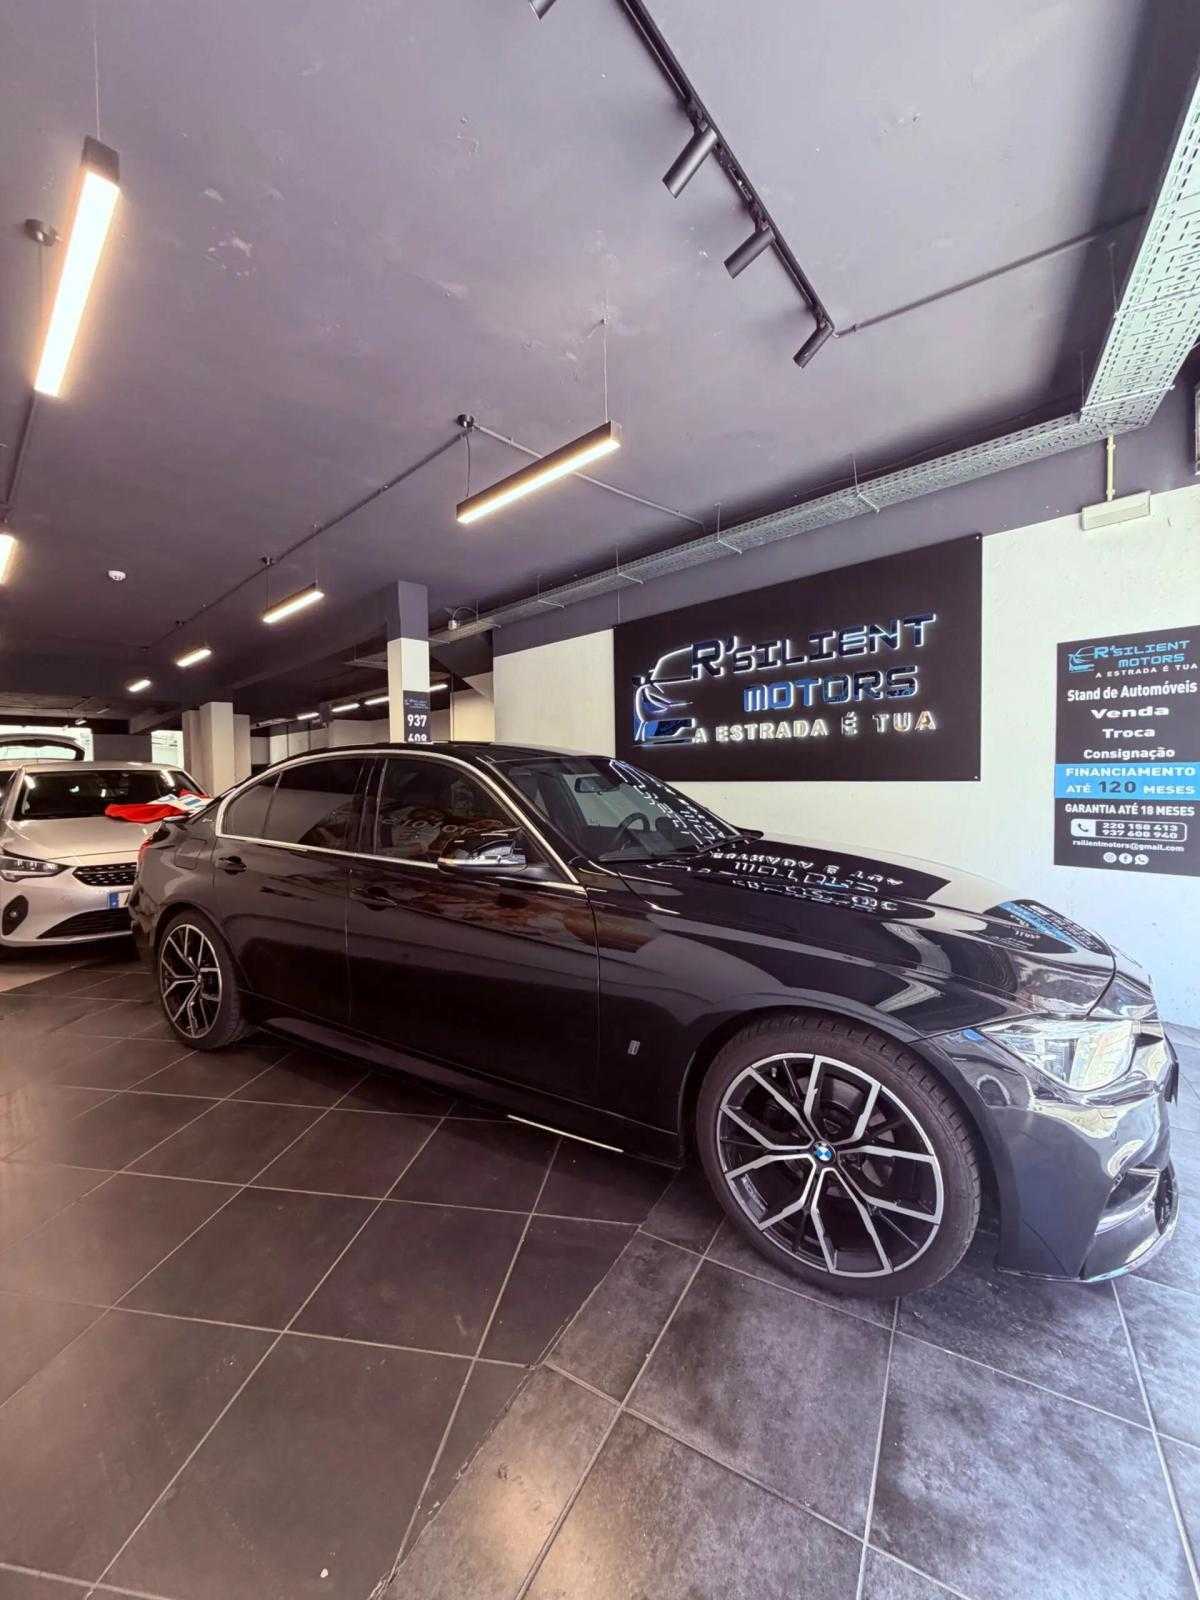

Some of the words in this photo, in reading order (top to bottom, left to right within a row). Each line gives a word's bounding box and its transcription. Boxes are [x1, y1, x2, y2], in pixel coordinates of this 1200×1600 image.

[1118, 653, 1185, 668] MOTORS
[1107, 668, 1157, 677] ESTRADA
[1175, 663, 1198, 671] TUA
[743, 665, 919, 713] MOTORS
[1067, 687, 1101, 701] Stand
[1103, 686, 1119, 699] de
[1121, 680, 1198, 698] Automóveis
[1091, 706, 1170, 719] Venda
[407, 714, 427, 727] 937
[692, 727, 708, 743] A
[715, 718, 828, 743] ESTRADA
[841, 712, 859, 737] É
[872, 710, 937, 733] TUA
[1102, 728, 1156, 739] Troca
[1083, 747, 1176, 760] Consignação
[1065, 767, 1196, 777] FINANCIAMENTO
[1066, 784, 1093, 793] ATÉ
[1099, 781, 1137, 793] 120
[1143, 785, 1196, 795] MESES
[1065, 803, 1116, 814] GARANTIA
[1118, 802, 1139, 815] ATÉ
[1141, 805, 1154, 815] 18
[1156, 806, 1195, 816] MESES
